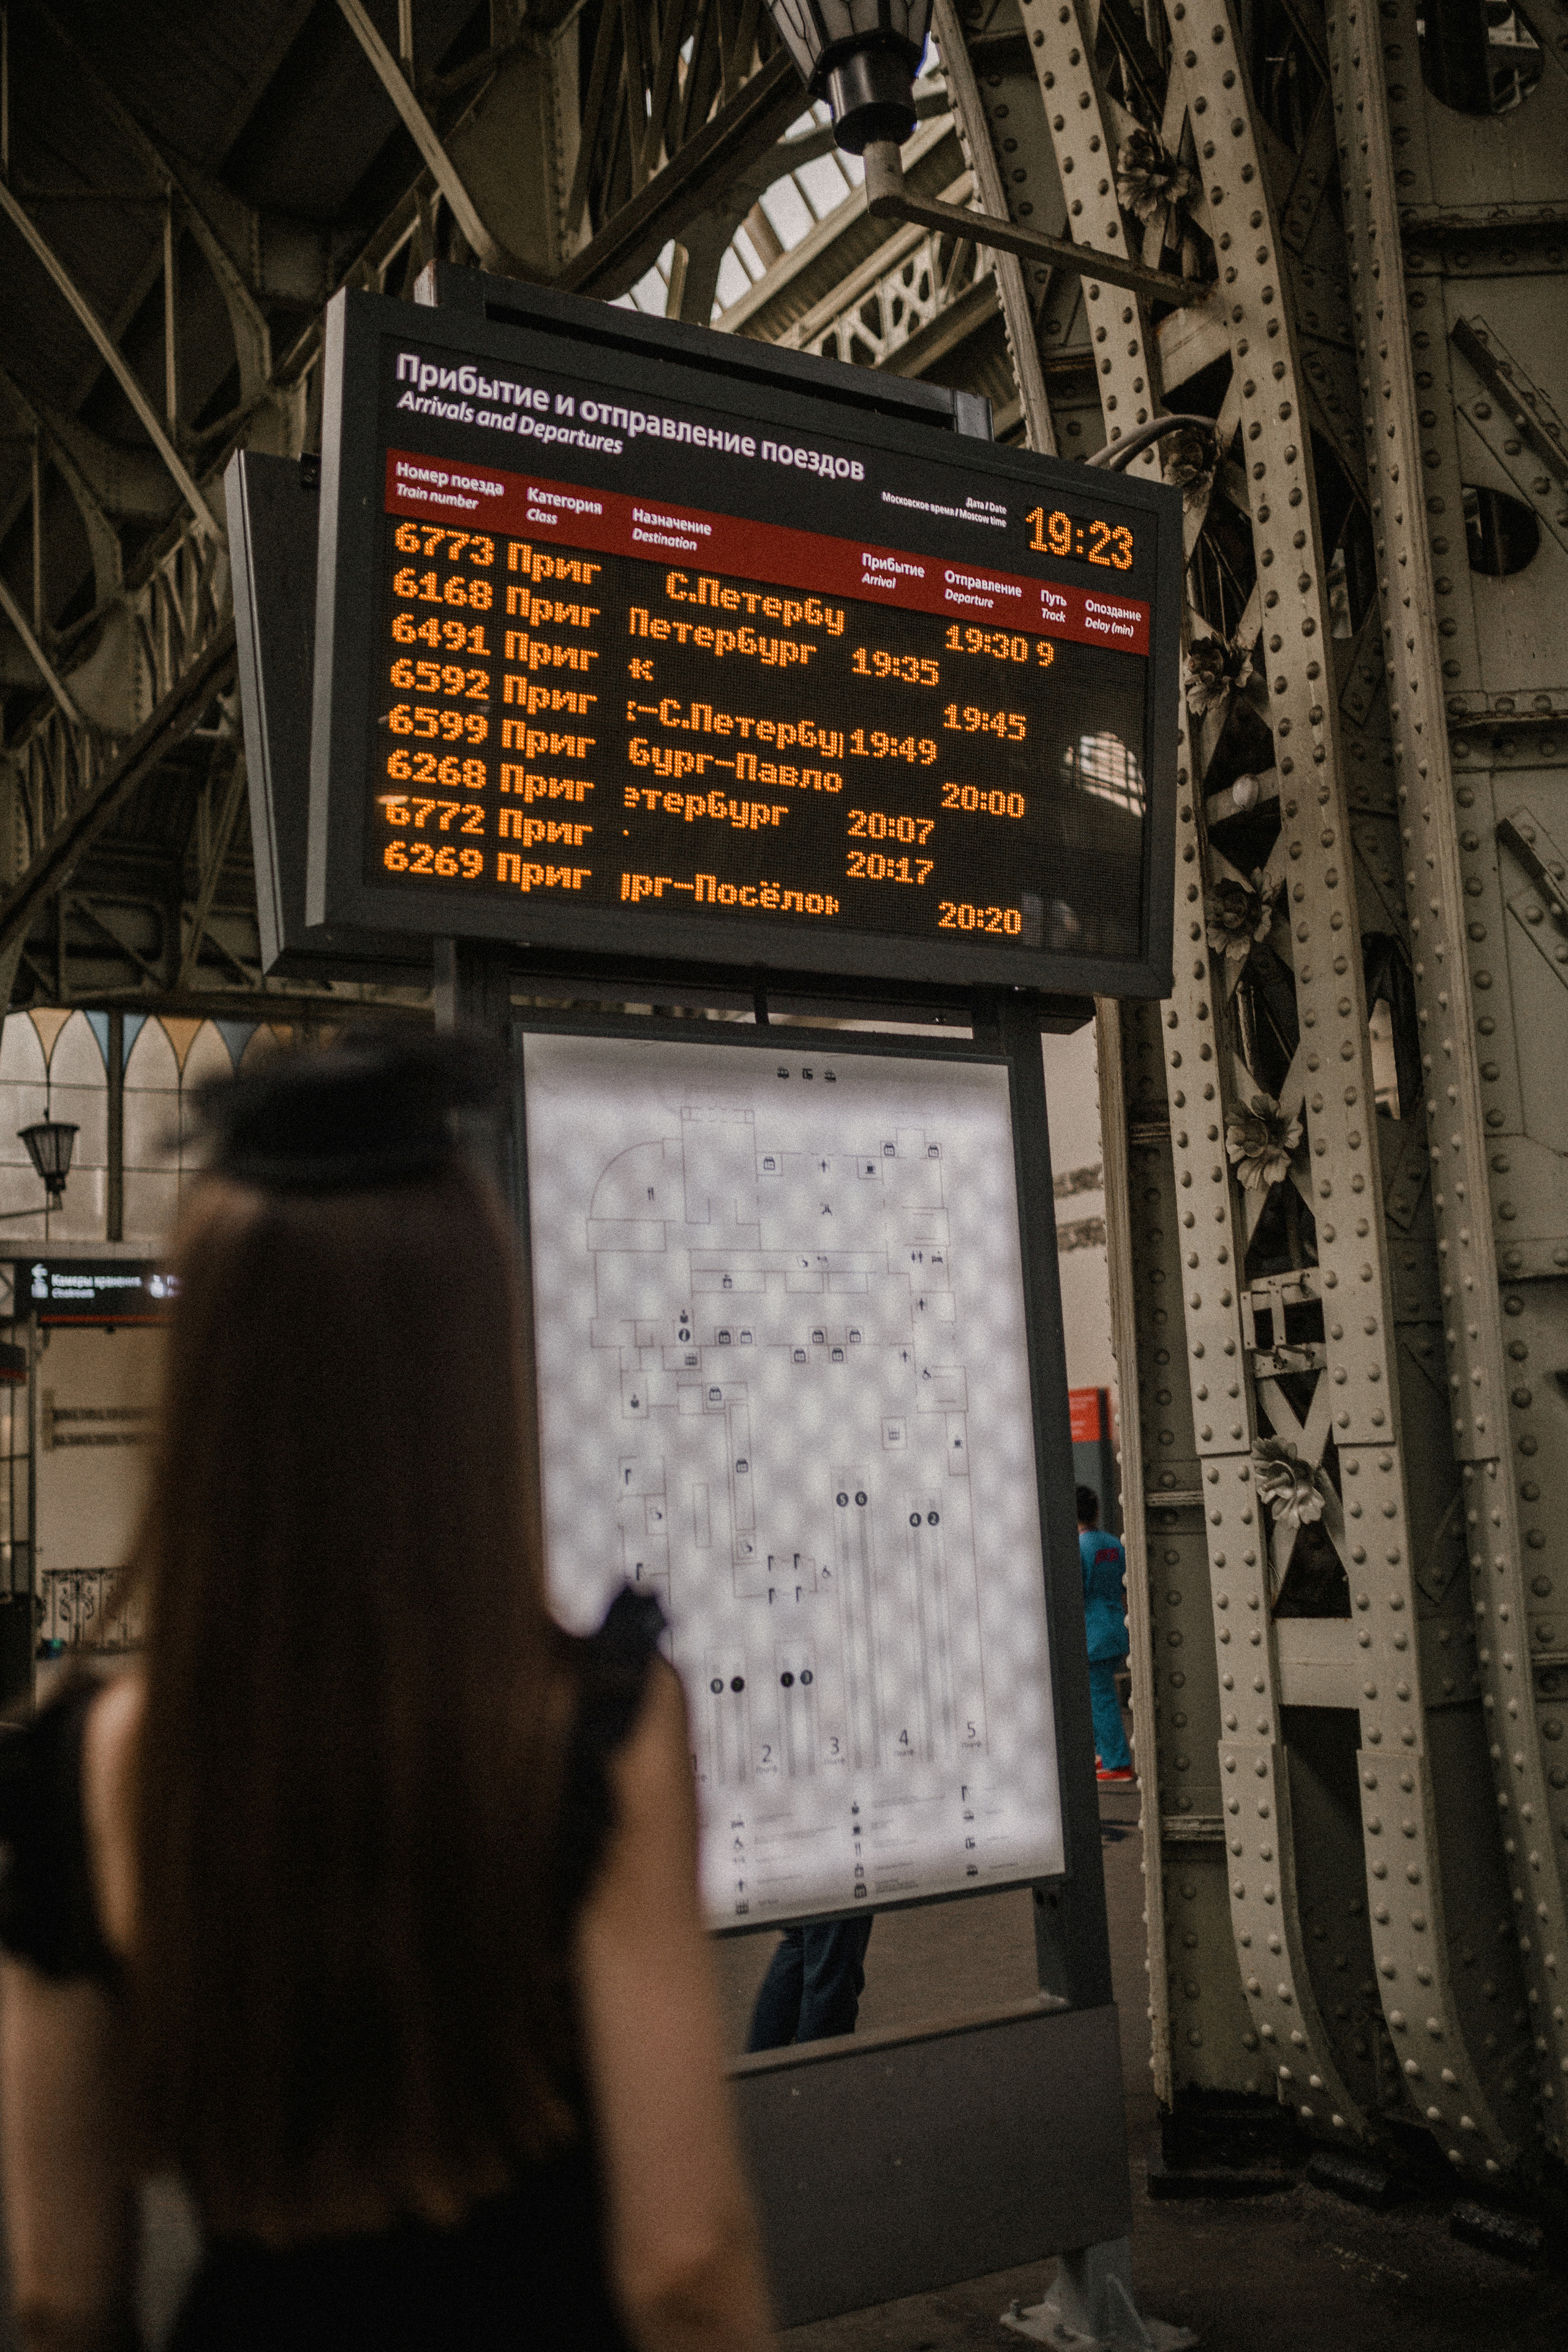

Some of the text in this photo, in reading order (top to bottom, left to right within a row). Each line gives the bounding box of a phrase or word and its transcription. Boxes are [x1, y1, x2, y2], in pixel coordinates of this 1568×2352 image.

[396, 353, 864, 481] Прибытие и отправление поездов
[397, 390, 623, 454] Arrivals and Departures
[396, 461, 504, 497] Номер поезда
[396, 483, 478, 510] Train number
[527, 486, 603, 515] Категория
[881, 491, 930, 511] Московское
[930, 503, 955, 516] время
[959, 508, 990, 524] Moscow
[990, 516, 1007, 527] time
[965, 497, 985, 511] Дата
[989, 502, 1007, 514] Date
[527, 508, 558, 526] Class
[633, 508, 712, 536] Назначение
[632, 527, 698, 551] Destination
[1026, 507, 1134, 570] 19:23
[862, 552, 925, 578] Прибытие
[394, 522, 1054, 667] 6773 Приг С.Петербу 19:30 9
[862, 573, 895, 589] Arrival
[944, 569, 1022, 598] Отправление
[944, 588, 993, 608] Departure
[1040, 589, 1068, 607] Путь
[1085, 599, 1142, 622] Опоздание
[393, 568, 940, 686] 6168 Приг Петербург 19:35
[1041, 608, 1066, 623] Track
[1085, 616, 1134, 638] Delay (min)
[391, 613, 491, 656] 6491
[504, 630, 599, 671] Приг
[943, 704, 1027, 741] 19:45
[390, 658, 490, 700] 6592
[503, 674, 598, 715] Приг
[850, 728, 938, 765] 19:49
[389, 704, 489, 744] 6599
[502, 719, 596, 758] Приг
[941, 783, 1025, 818] 20:00
[387, 748, 486, 789] 6268
[500, 763, 595, 804] Приг
[848, 809, 935, 845] 20:07
[385, 796, 933, 884] 6772 Приг 20:17
[383, 841, 484, 879] 6269
[497, 852, 592, 892] Приг
[938, 902, 1022, 934] 20:20
[899, 1728, 908, 1746] 4
[967, 1721, 976, 1738] 5
[762, 1744, 772, 1763] 2
[830, 1736, 839, 1755] 3
